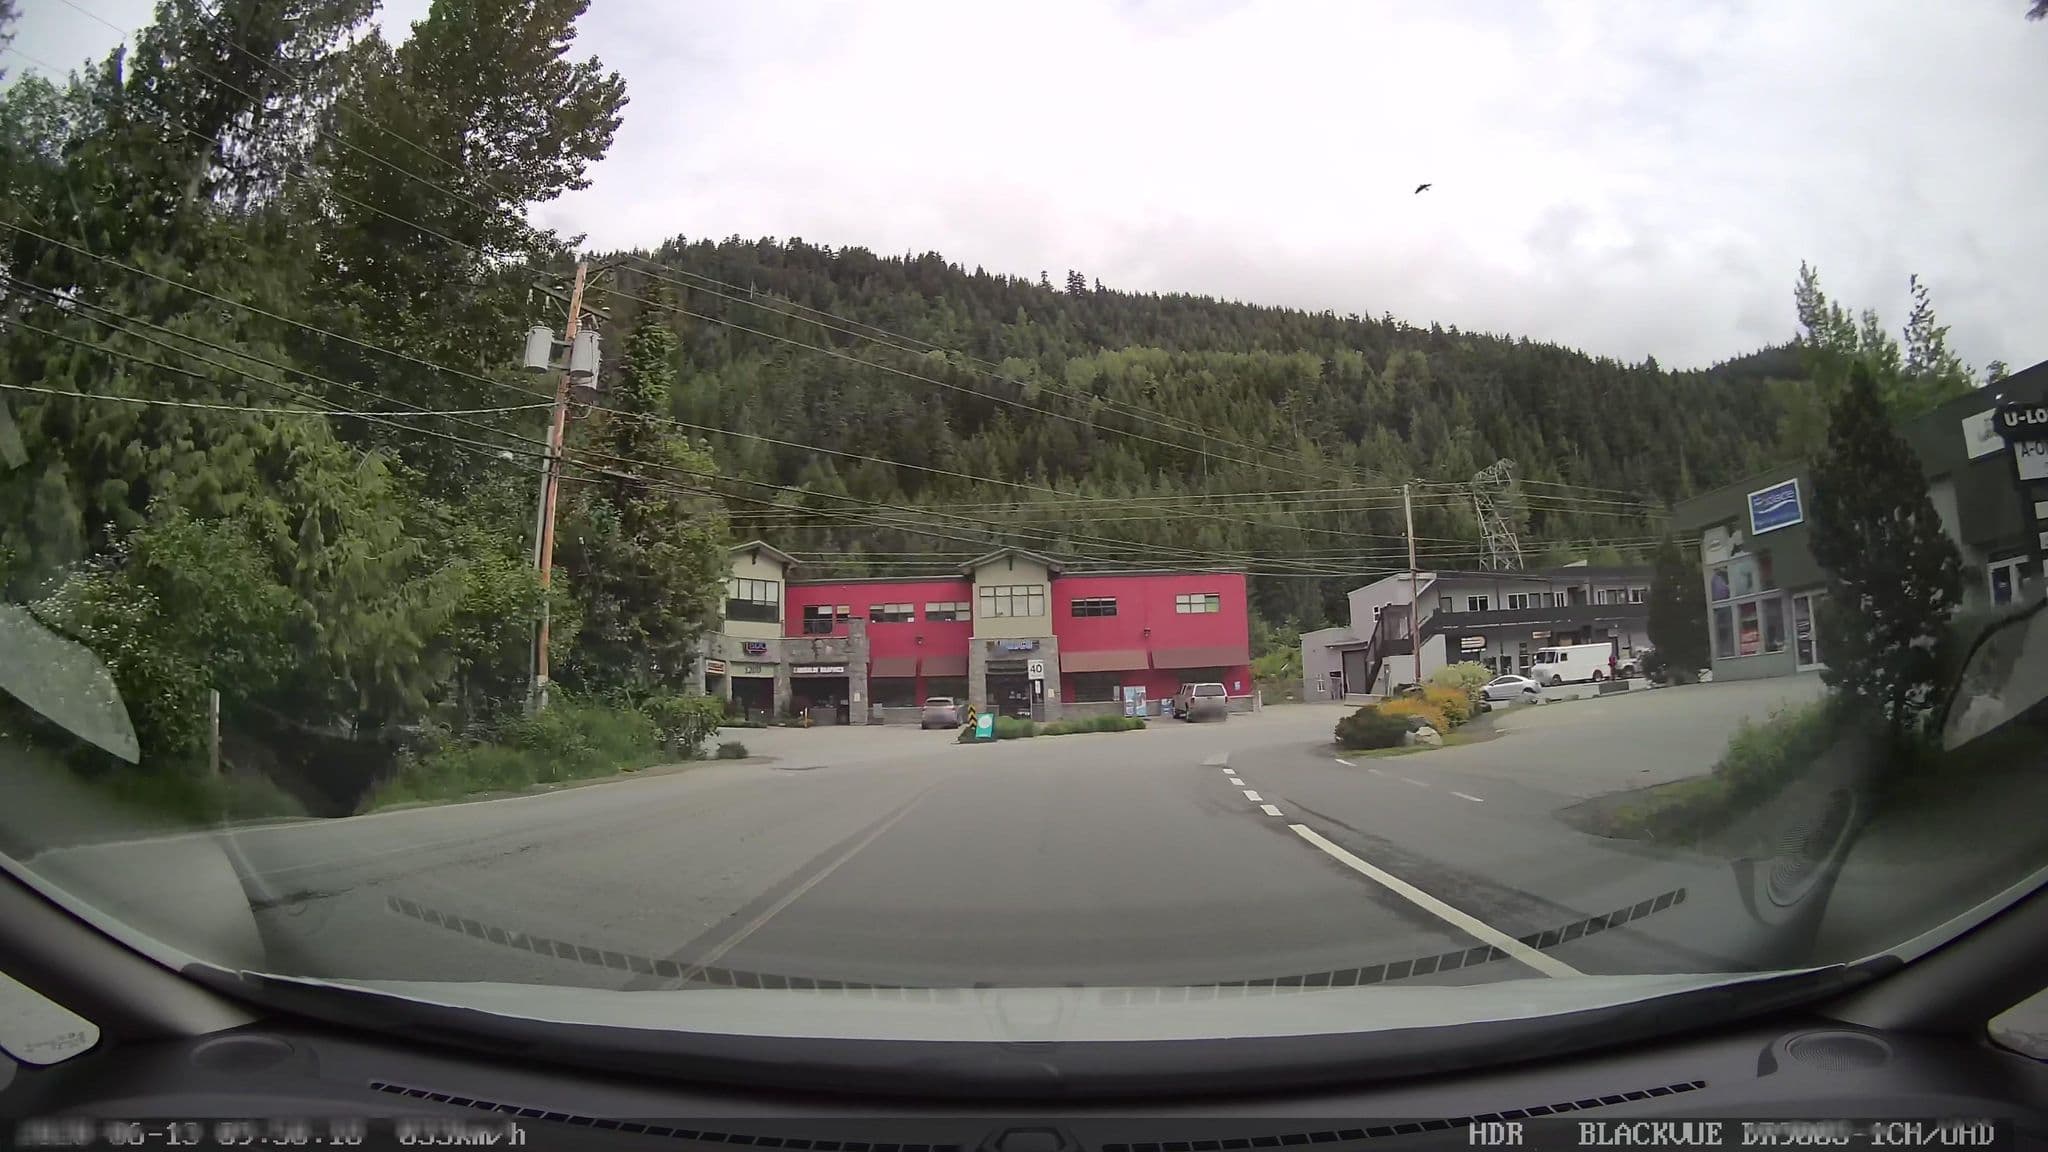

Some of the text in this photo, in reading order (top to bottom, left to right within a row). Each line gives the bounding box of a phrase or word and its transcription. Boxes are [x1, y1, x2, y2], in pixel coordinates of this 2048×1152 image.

[2004, 408, 2048, 426] U-LO
[2022, 441, 2048, 457] A-O
[1030, 663, 1043, 673] 40
